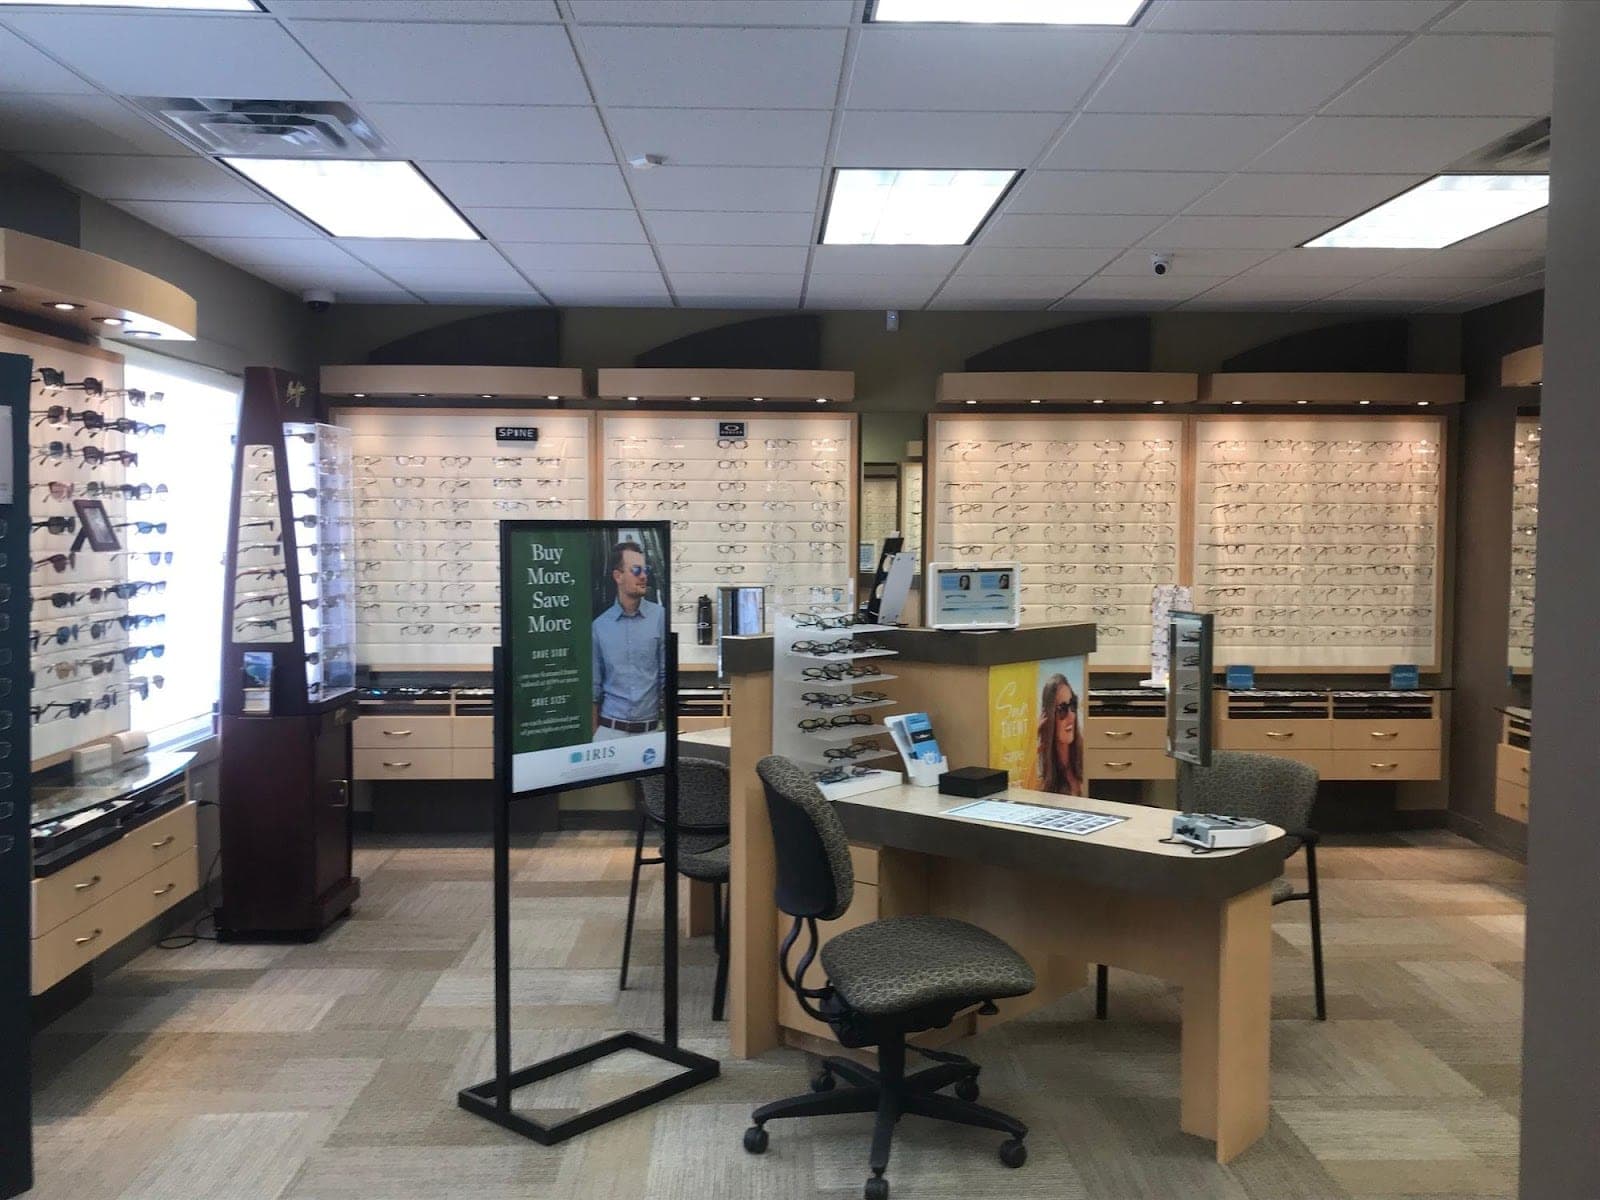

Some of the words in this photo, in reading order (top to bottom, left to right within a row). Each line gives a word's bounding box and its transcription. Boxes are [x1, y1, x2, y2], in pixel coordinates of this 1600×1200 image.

[530, 543, 564, 565] Buy
[527, 567, 576, 586] More,
[532, 591, 570, 609] Save
[528, 615, 572, 633] More
[532, 649, 549, 660] SAVE
[531, 697, 549, 708] SAVE
[586, 746, 616, 761] IRIS
